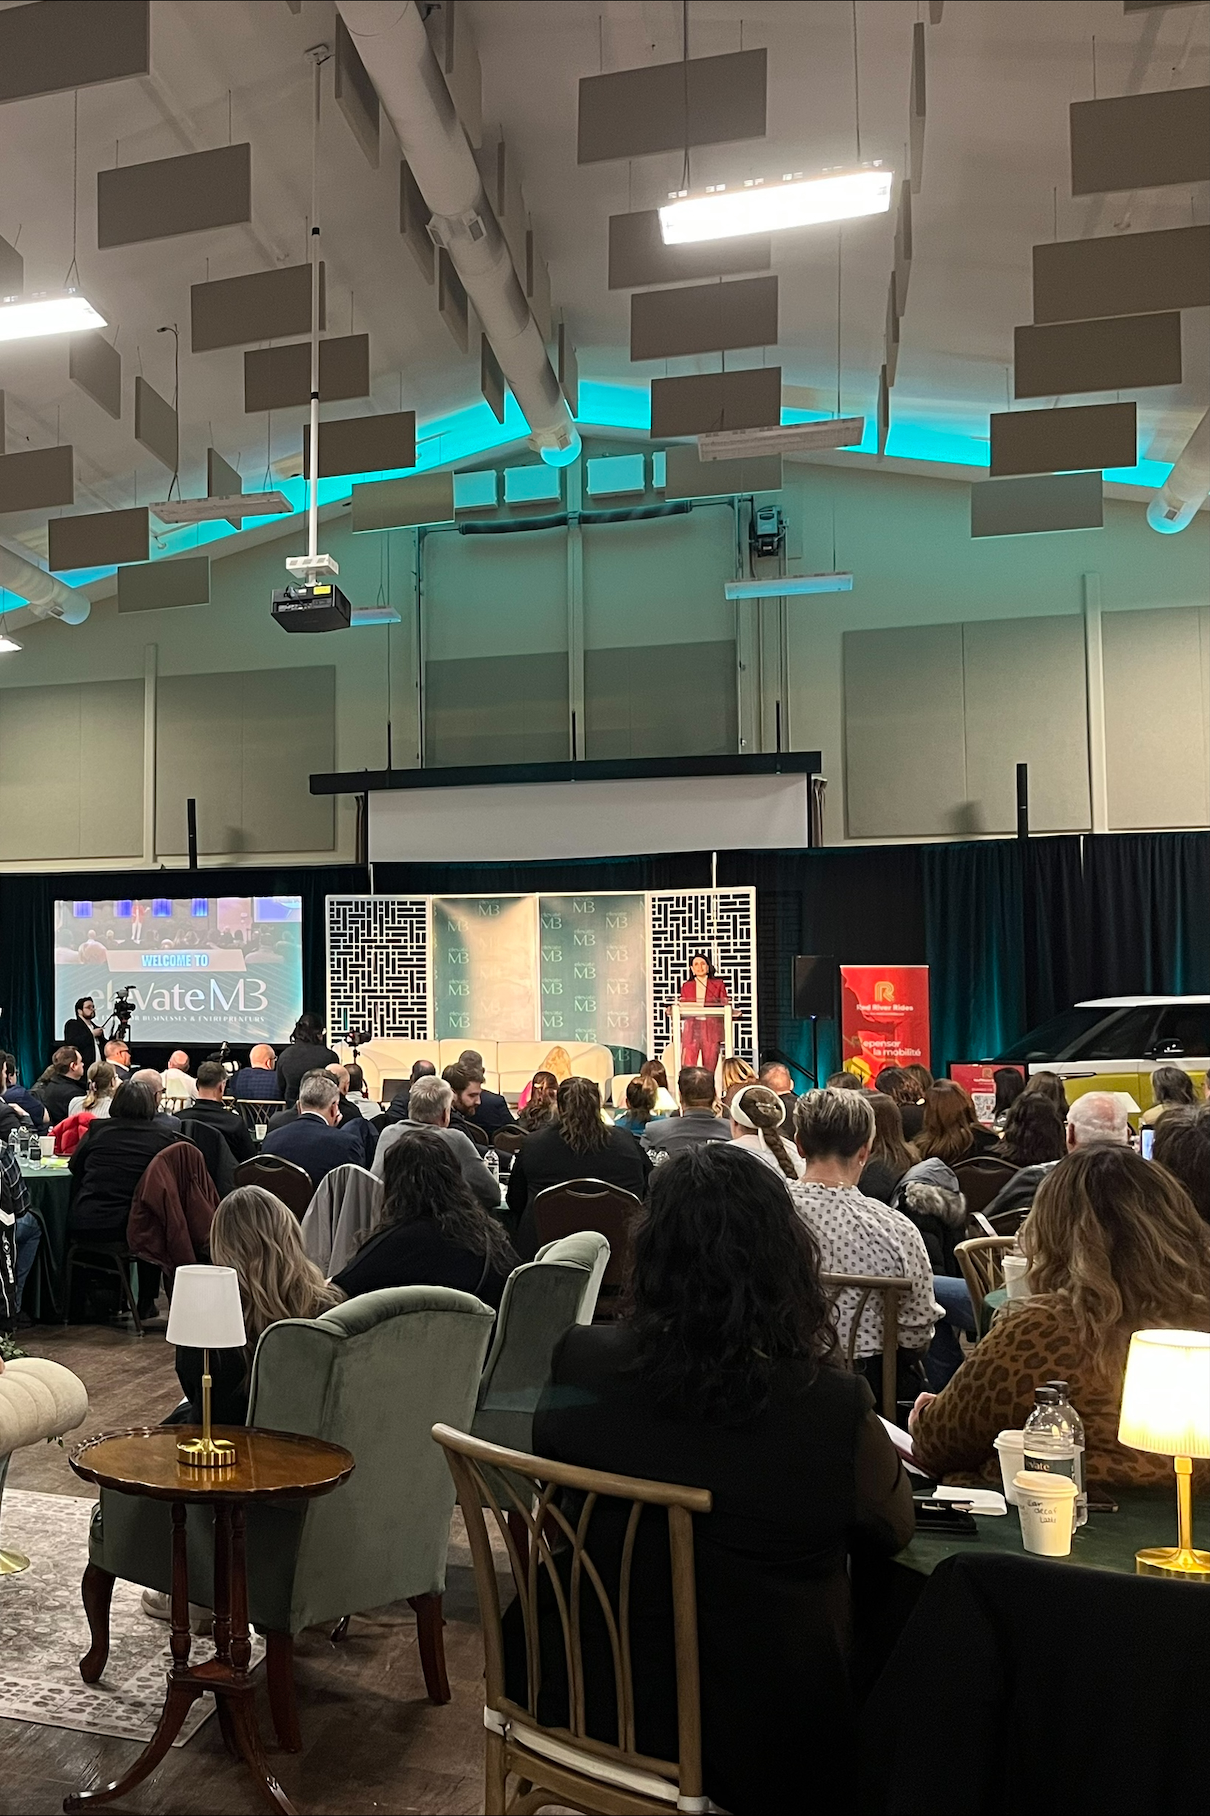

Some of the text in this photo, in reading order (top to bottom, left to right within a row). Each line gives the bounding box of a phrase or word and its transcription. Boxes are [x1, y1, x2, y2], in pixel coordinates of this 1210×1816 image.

[478, 904, 500, 916] MB
[572, 901, 596, 913] MB
[541, 917, 563, 929] MB
[606, 916, 629, 929] MB
[573, 934, 596, 946] MB
[141, 954, 209, 967] WELCOME TO
[448, 952, 470, 964] MB
[541, 950, 563, 962] MB
[606, 950, 629, 962] MB
[574, 967, 597, 979] MB
[448, 984, 470, 996] MB
[541, 982, 564, 995] MB
[606, 983, 630, 995] MB
[574, 1000, 597, 1012] MB
[449, 1016, 471, 1028] MB
[542, 1015, 564, 1028] MB
[607, 1015, 630, 1028] MB
[873, 1048, 922, 1056] la mobilité
